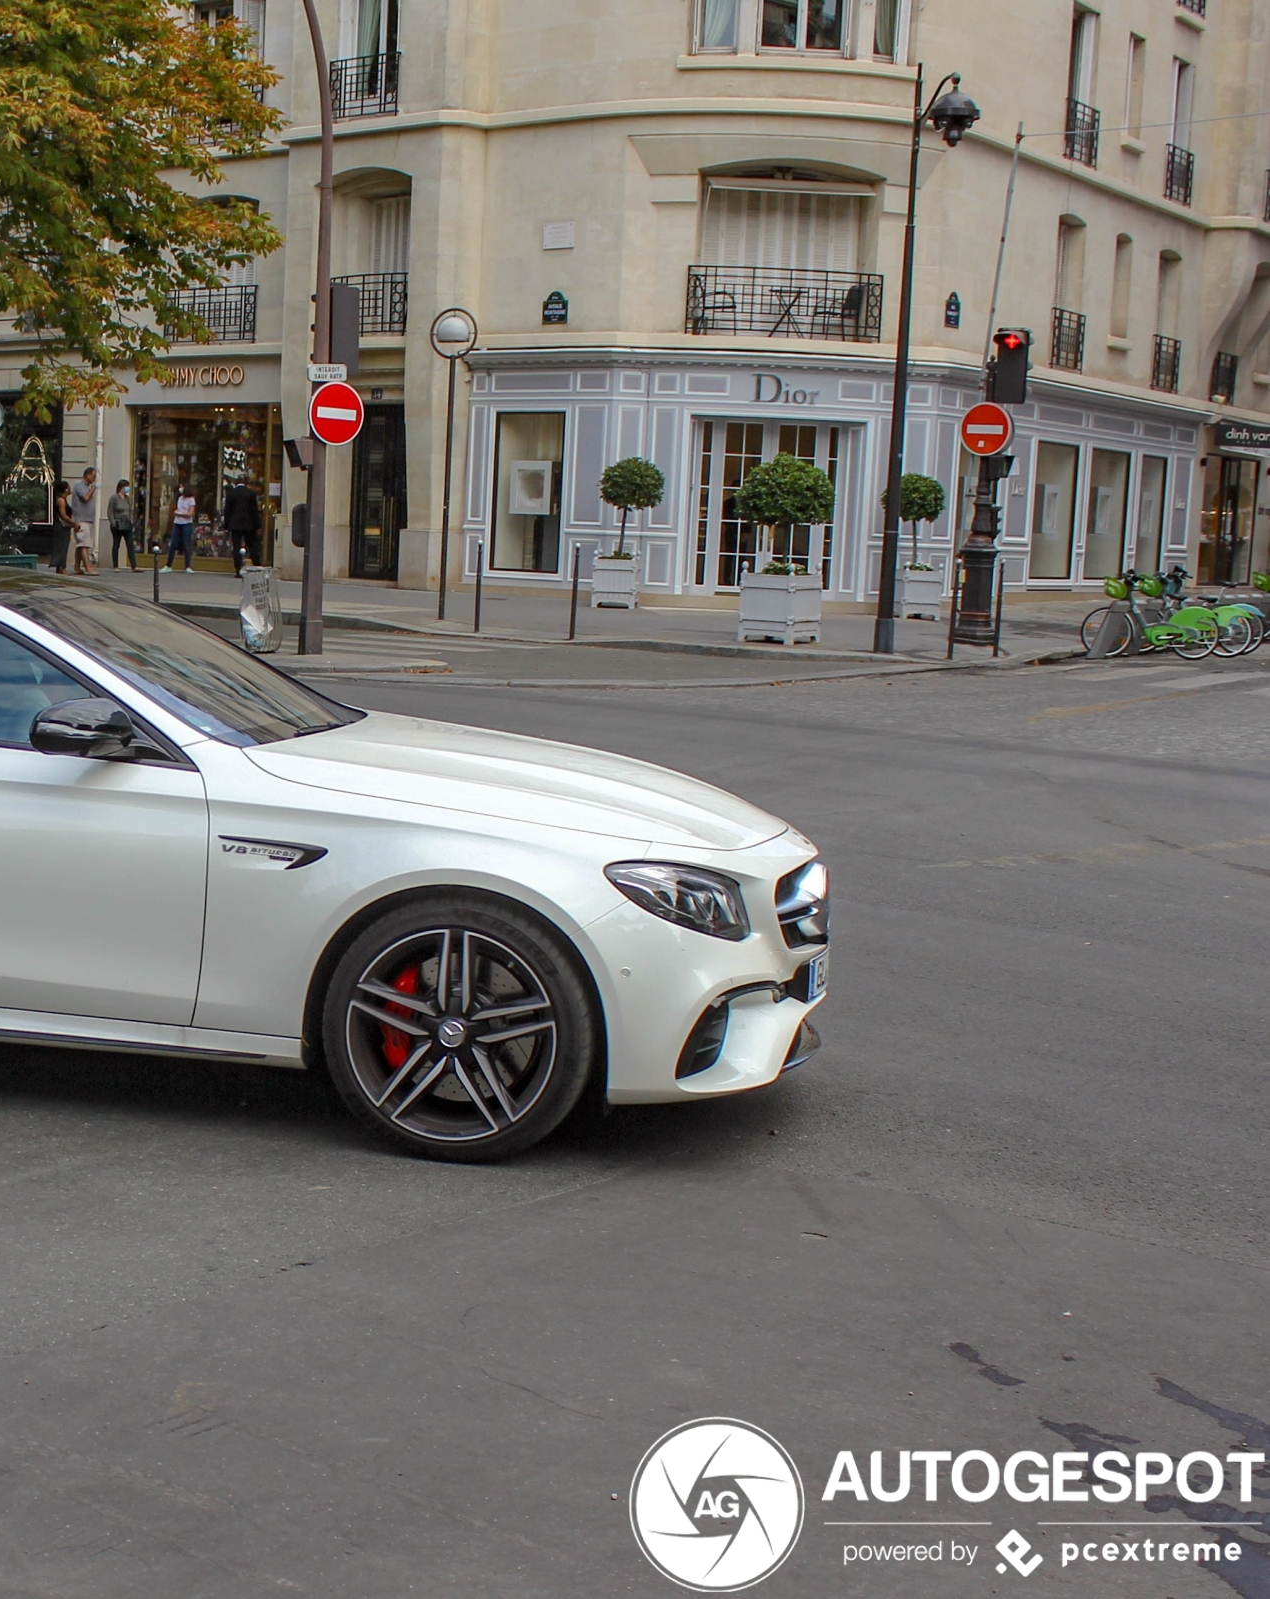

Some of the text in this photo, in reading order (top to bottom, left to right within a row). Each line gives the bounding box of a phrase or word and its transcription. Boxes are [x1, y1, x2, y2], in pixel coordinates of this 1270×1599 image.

[199, 365, 244, 385] CHOO
[751, 373, 820, 405] Dior
[1225, 427, 1250, 440] dinh
[221, 843, 249, 854] V8
[250, 847, 296, 858] BITURBO
